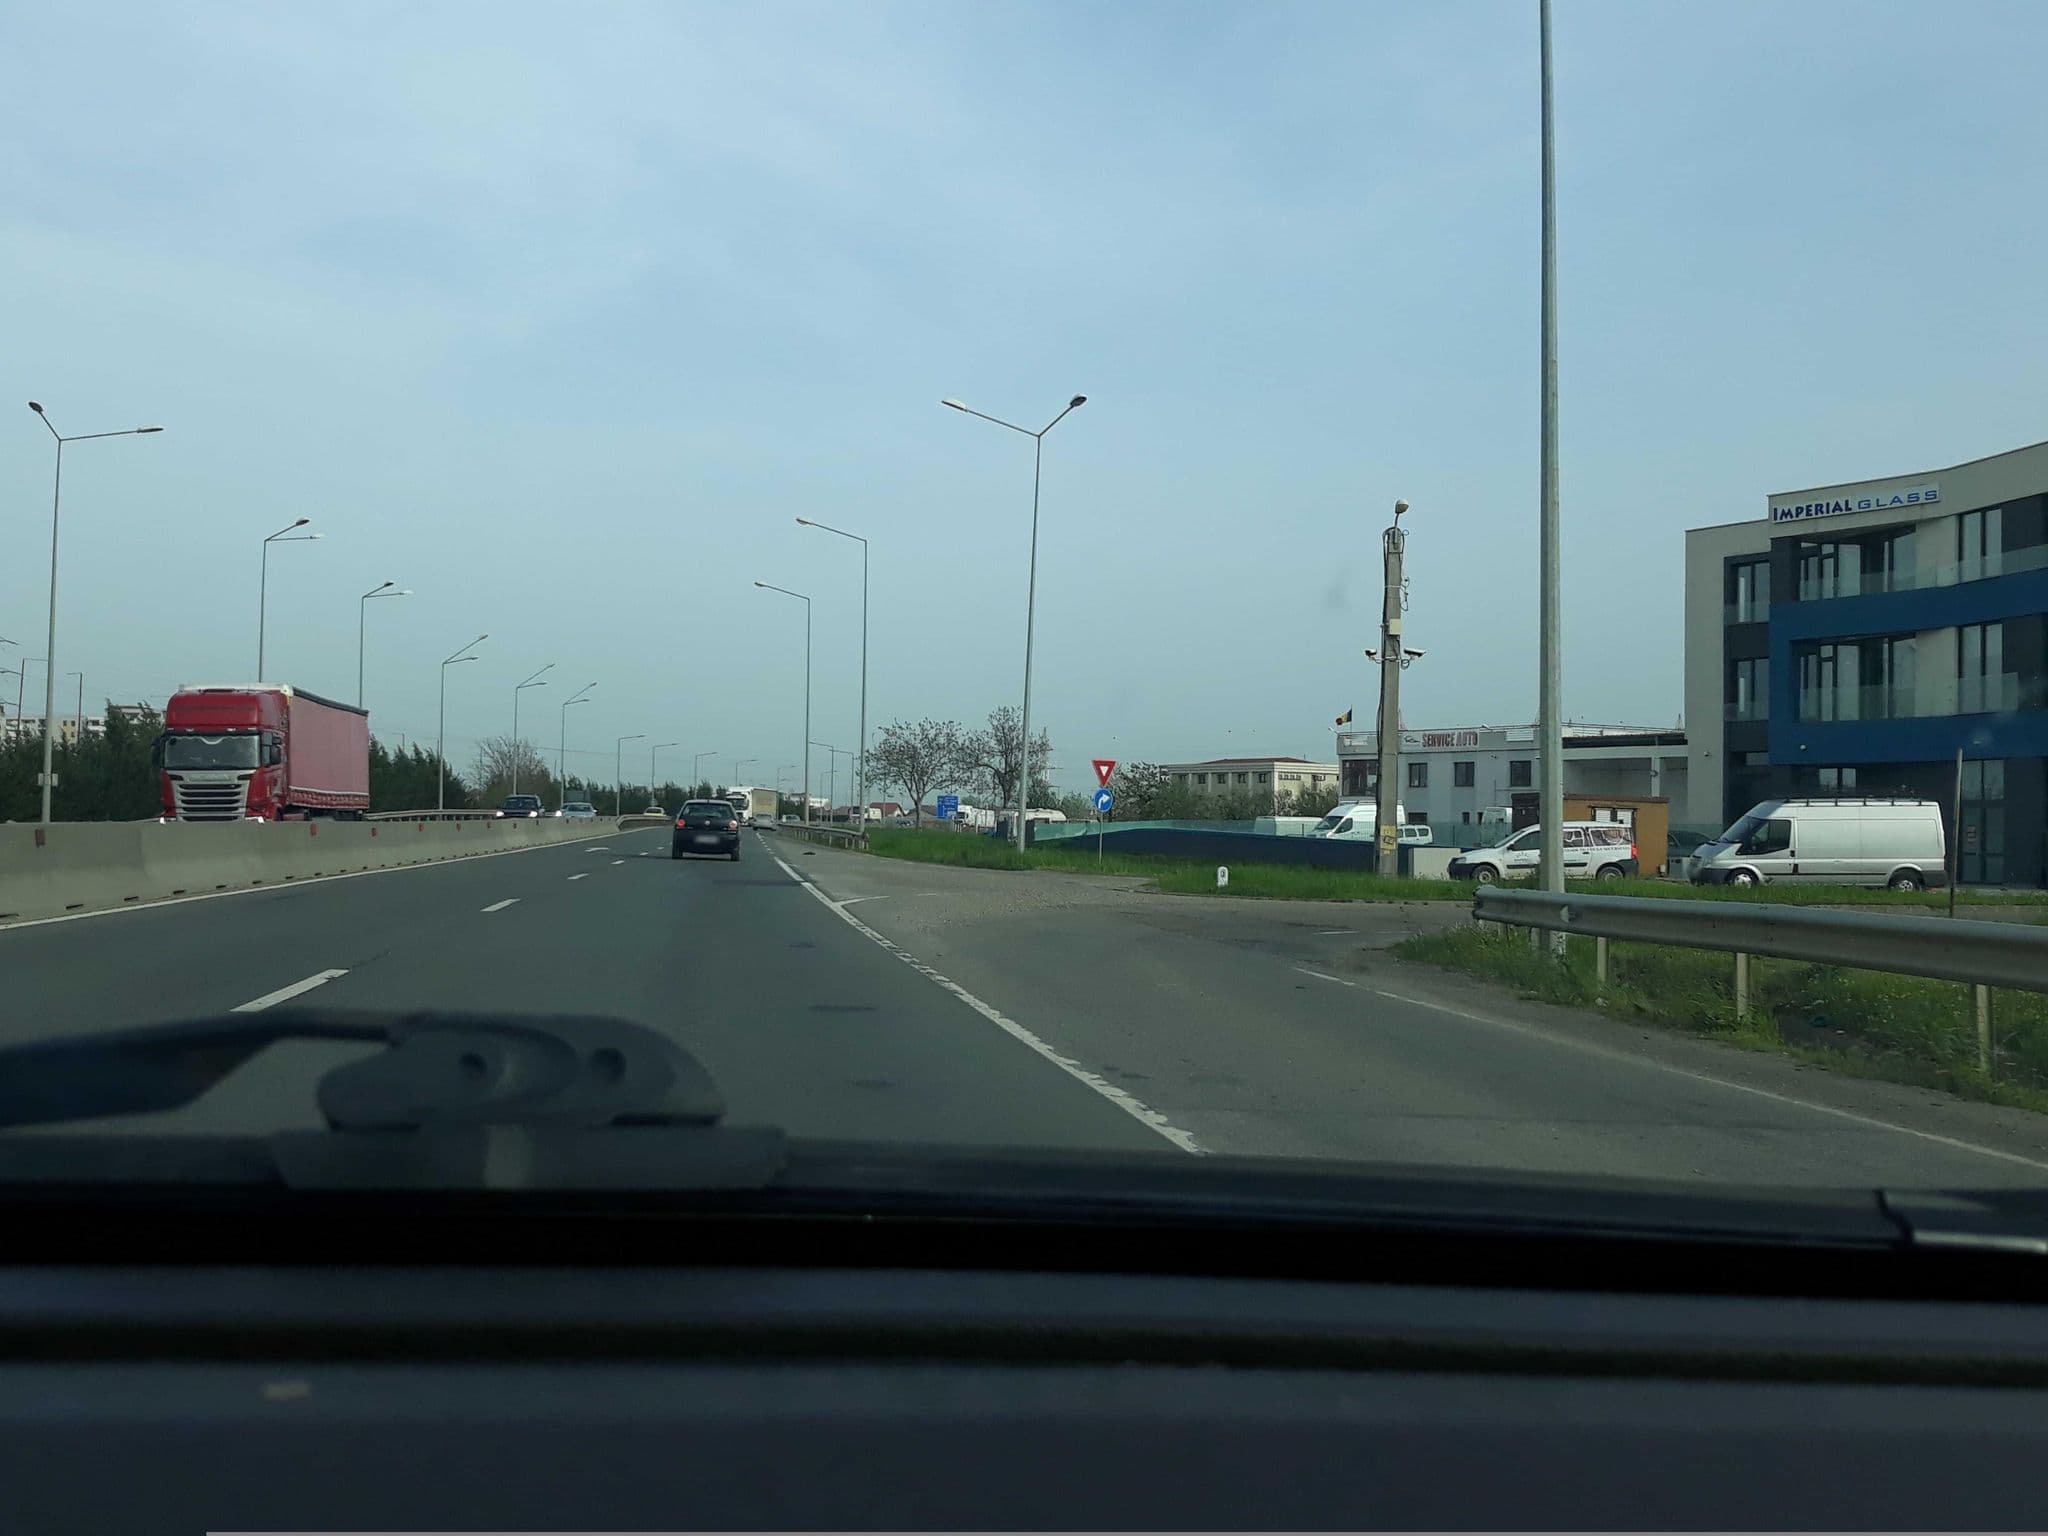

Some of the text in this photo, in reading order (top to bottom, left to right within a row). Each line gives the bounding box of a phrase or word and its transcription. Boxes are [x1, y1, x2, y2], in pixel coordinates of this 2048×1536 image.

[1773, 490, 1938, 521] IMPERIAL GLASS
[1422, 731, 1478, 748] SERVICE AUTO
